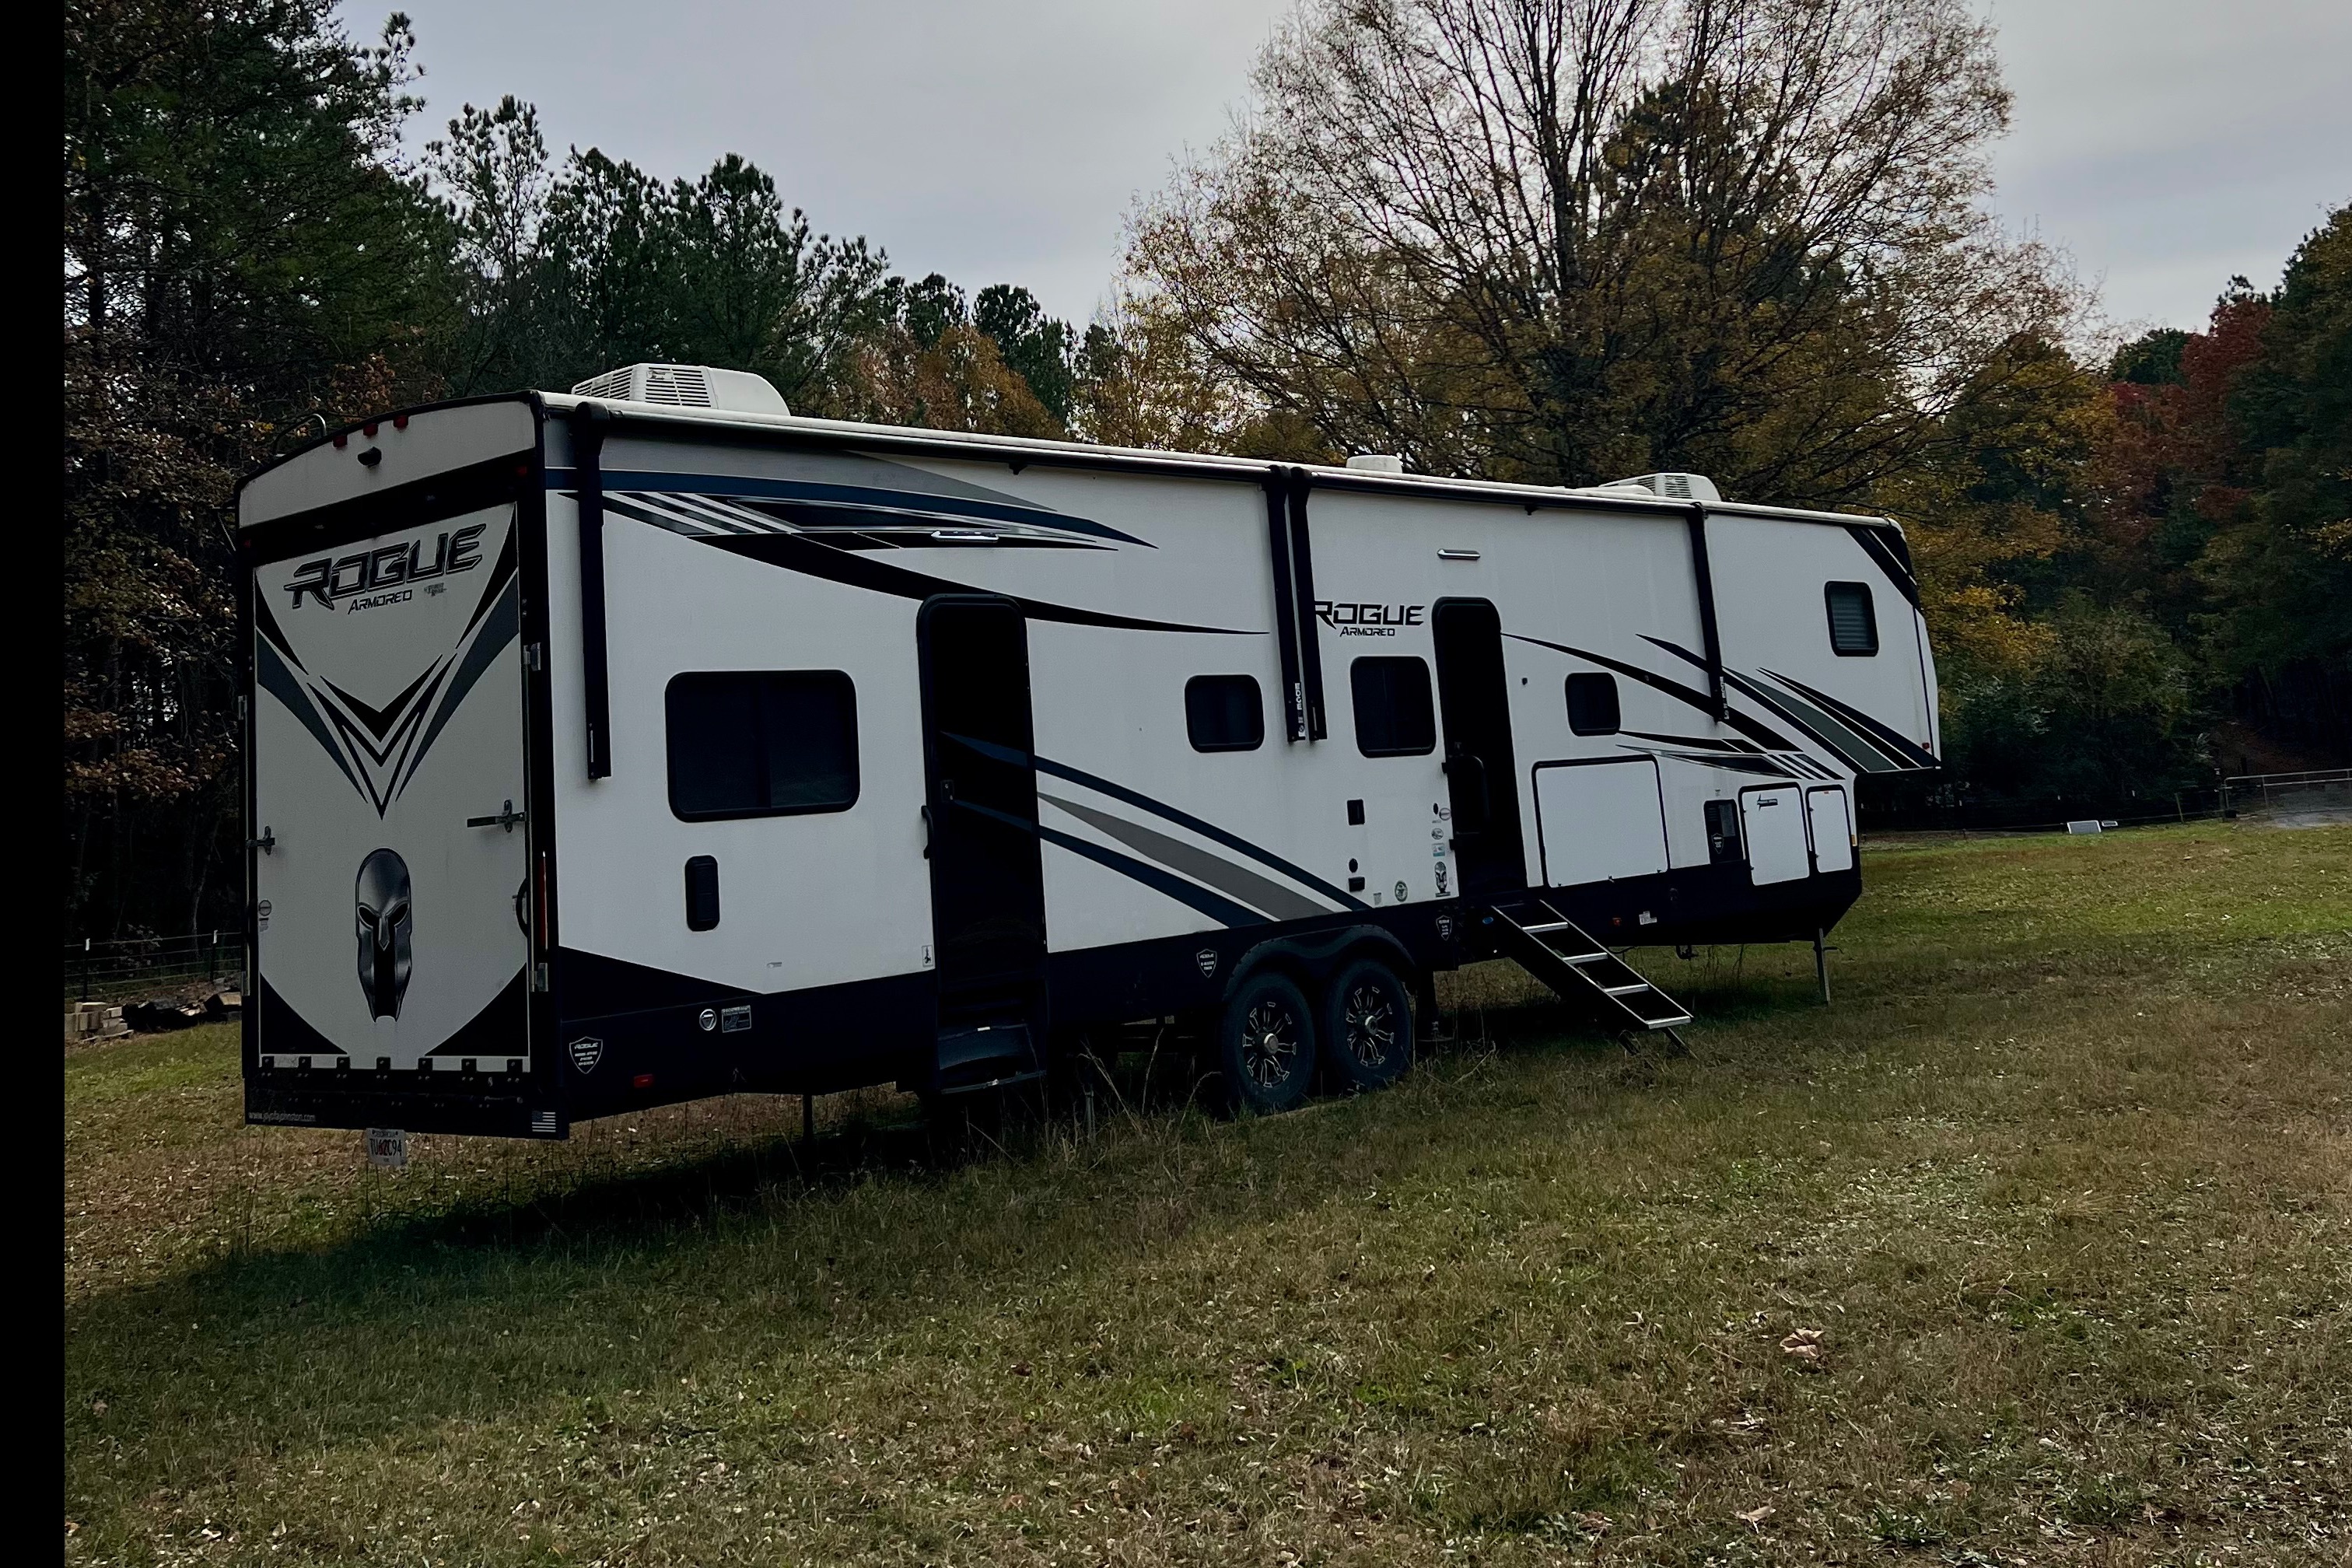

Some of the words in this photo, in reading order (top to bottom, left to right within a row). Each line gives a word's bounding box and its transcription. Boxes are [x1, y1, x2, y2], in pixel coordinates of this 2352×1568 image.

[284, 523, 487, 611] ROGUE
[348, 590, 413, 614] ARMORED
[1314, 600, 1425, 630] ROGUE
[1339, 626, 1395, 637] ARMORED
